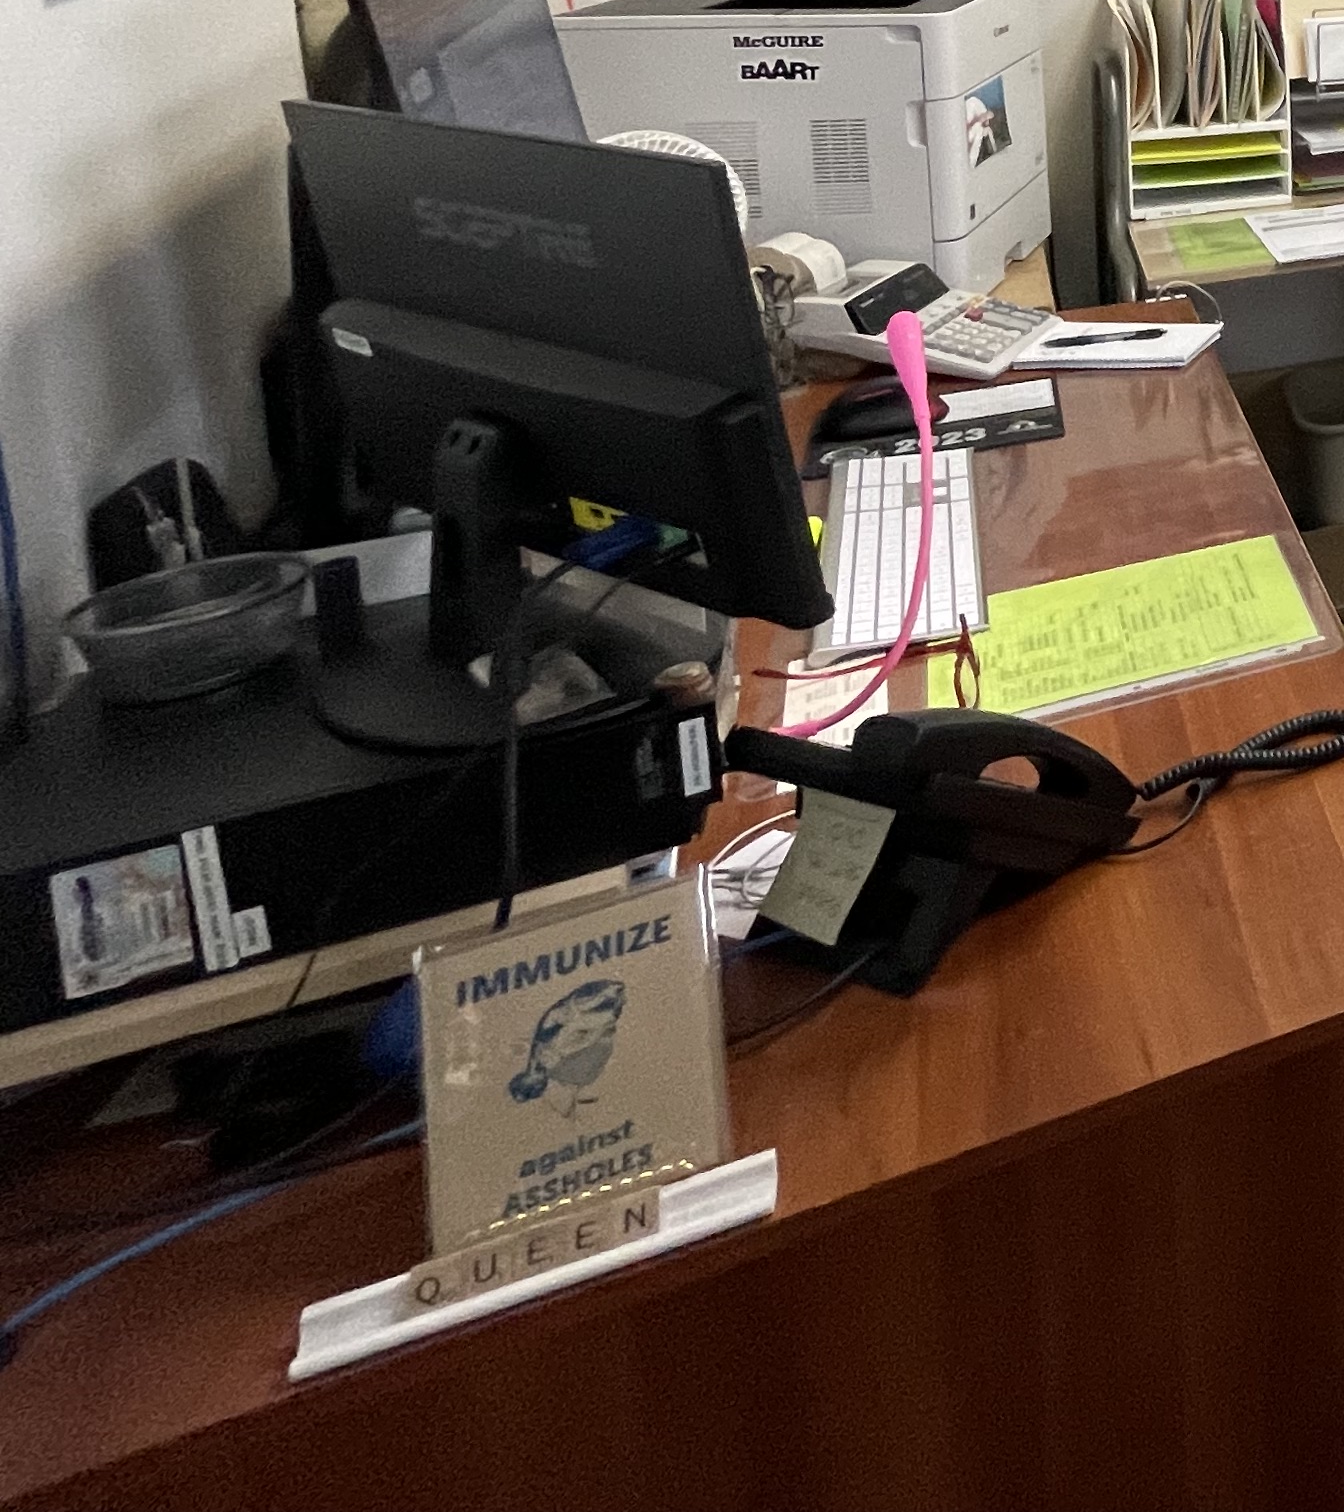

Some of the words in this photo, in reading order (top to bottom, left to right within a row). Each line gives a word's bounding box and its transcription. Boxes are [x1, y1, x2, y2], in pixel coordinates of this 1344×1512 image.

[732, 35, 824, 48] McGUIRE
[455, 913, 673, 1007] IMMUNIZE
[500, 1143, 655, 1219] ASSHOLES
[518, 1119, 635, 1179] against
[414, 1203, 647, 1306] QUEEN
